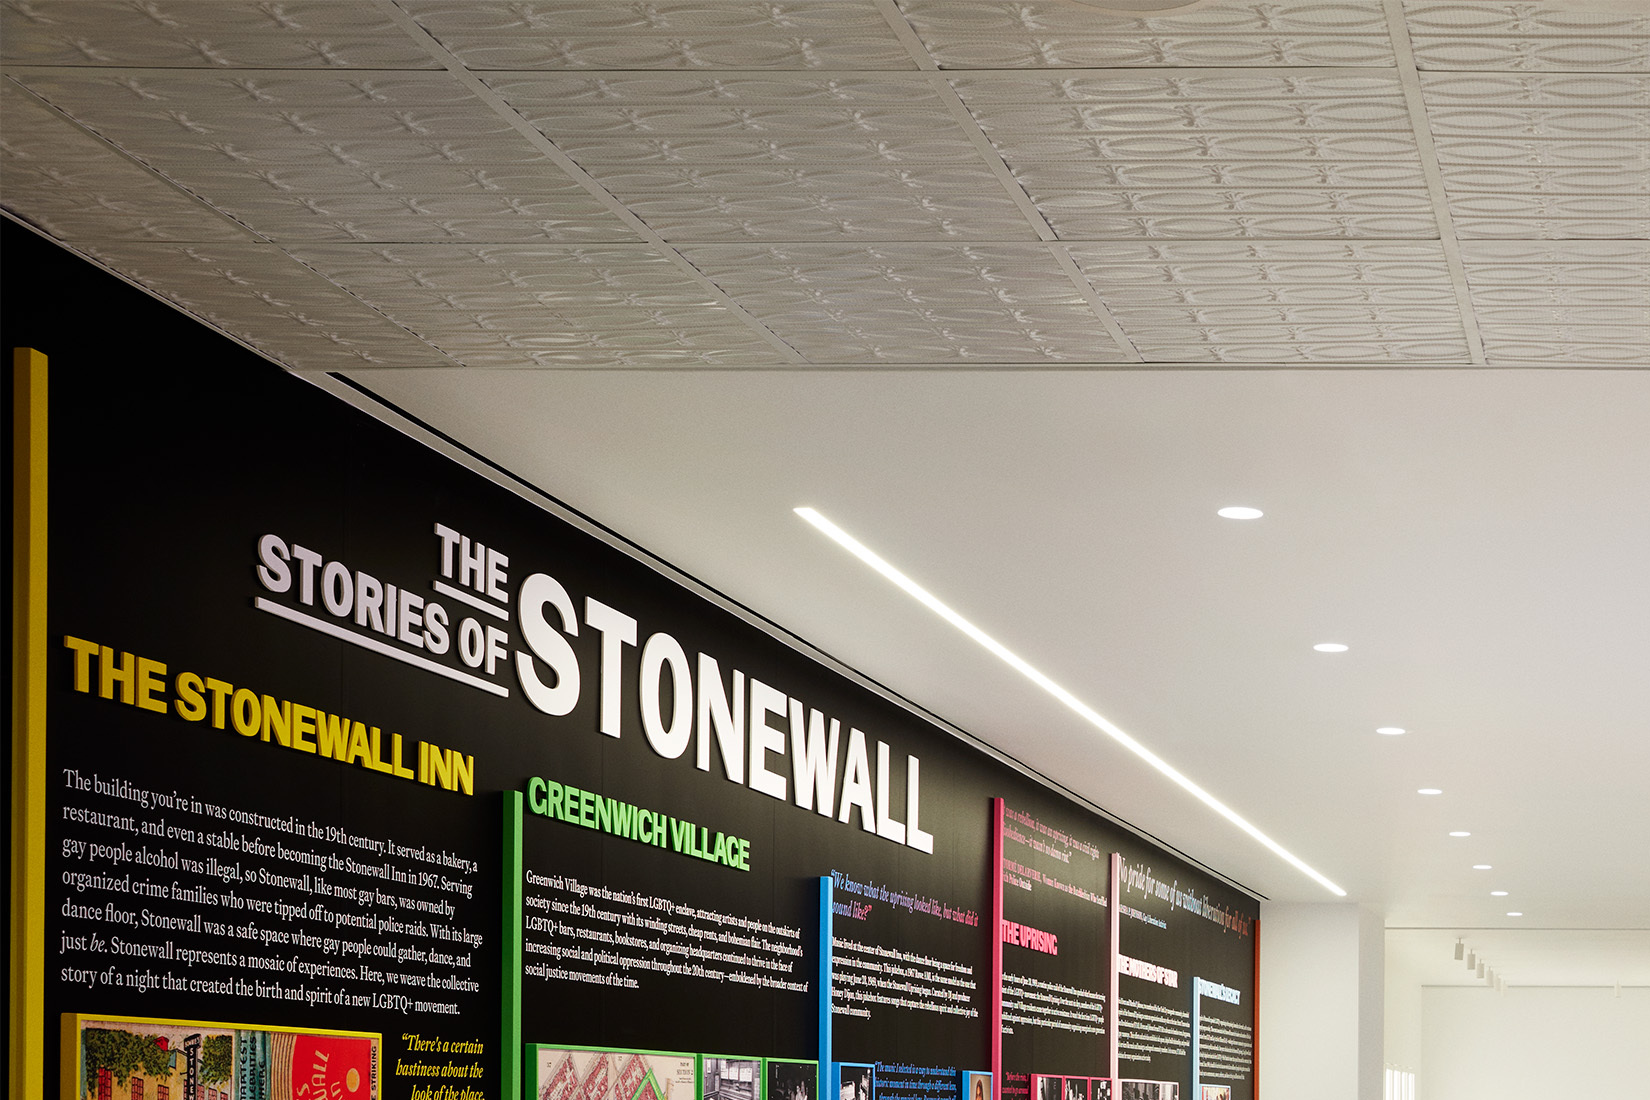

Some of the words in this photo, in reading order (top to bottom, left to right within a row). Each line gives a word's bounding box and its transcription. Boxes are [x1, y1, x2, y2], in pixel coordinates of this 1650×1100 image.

[434, 522, 509, 603] THE
[256, 534, 450, 655] STORIES
[458, 617, 509, 675] OF
[63, 634, 167, 714] THE
[174, 671, 414, 780] STONEWALL
[418, 740, 474, 796] INN
[515, 572, 933, 854] STONEWALL
[62, 768, 91, 791] The
[94, 773, 149, 809] building
[150, 790, 188, 811] you’re
[190, 795, 202, 814] in
[204, 803, 227, 819] was
[228, 808, 293, 833] constructed
[295, 818, 305, 836] in
[307, 821, 324, 840] the
[325, 825, 347, 845] 19th
[348, 835, 386, 857] century.
[387, 839, 395, 855] It
[396, 845, 425, 861] served
[425, 851, 435, 863] as
[436, 853, 442, 865] a
[442, 850, 472, 874] bakery,
[472, 861, 478, 872] a
[63, 806, 139, 836] restaurant,
[141, 818, 165, 837] and
[166, 826, 195, 843] even
[197, 831, 204, 844] a
[206, 830, 239, 851] stable
[241, 834, 275, 858] before
[277, 841, 327, 872] becoming
[328, 852, 344, 871] the
[345, 856, 390, 880] Stonewall
[391, 865, 407, 883] Inn
[408, 868, 417, 885] in
[418, 871, 439, 889] 1967.
[440, 875, 473, 900] Serving
[527, 776, 667, 849] GREENWICH
[669, 817, 750, 871] VILLAGE
[526, 870, 564, 890] Greenwich
[565, 878, 588, 898] Village
[589, 886, 601, 897] was
[602, 886, 612, 900] the
[613, 890, 636, 905] nation’s
[636, 893, 649, 907] first
[649, 896, 675, 915] LGBTQ+
[831, 869, 844, 889] “We
[845, 874, 862, 894] know
[864, 881, 878, 900] what
[880, 885, 889, 901] the
[890, 891, 914, 913] uprising
[914, 894, 931, 913] looked
[932, 899, 942, 919] like,
[943, 902, 952, 920] but
[953, 907, 964, 923] what
[965, 910, 973, 925] did
[525, 963, 545, 976] social
[545, 964, 568, 981] justice
[569, 970, 605, 985] movements
[606, 972, 614, 985] of
[613, 973, 623, 986] the
[624, 975, 640, 988] time.
[1002, 918, 1019, 946] THE
[1020, 924, 1058, 955] UPRISING
[395, 1058, 440, 1077] hastiness
[440, 1060, 469, 1078] about
[469, 1061, 484, 1078] the
[402, 1033, 441, 1052] “There's
[443, 1042, 449, 1052] a
[451, 1038, 484, 1054] certain
